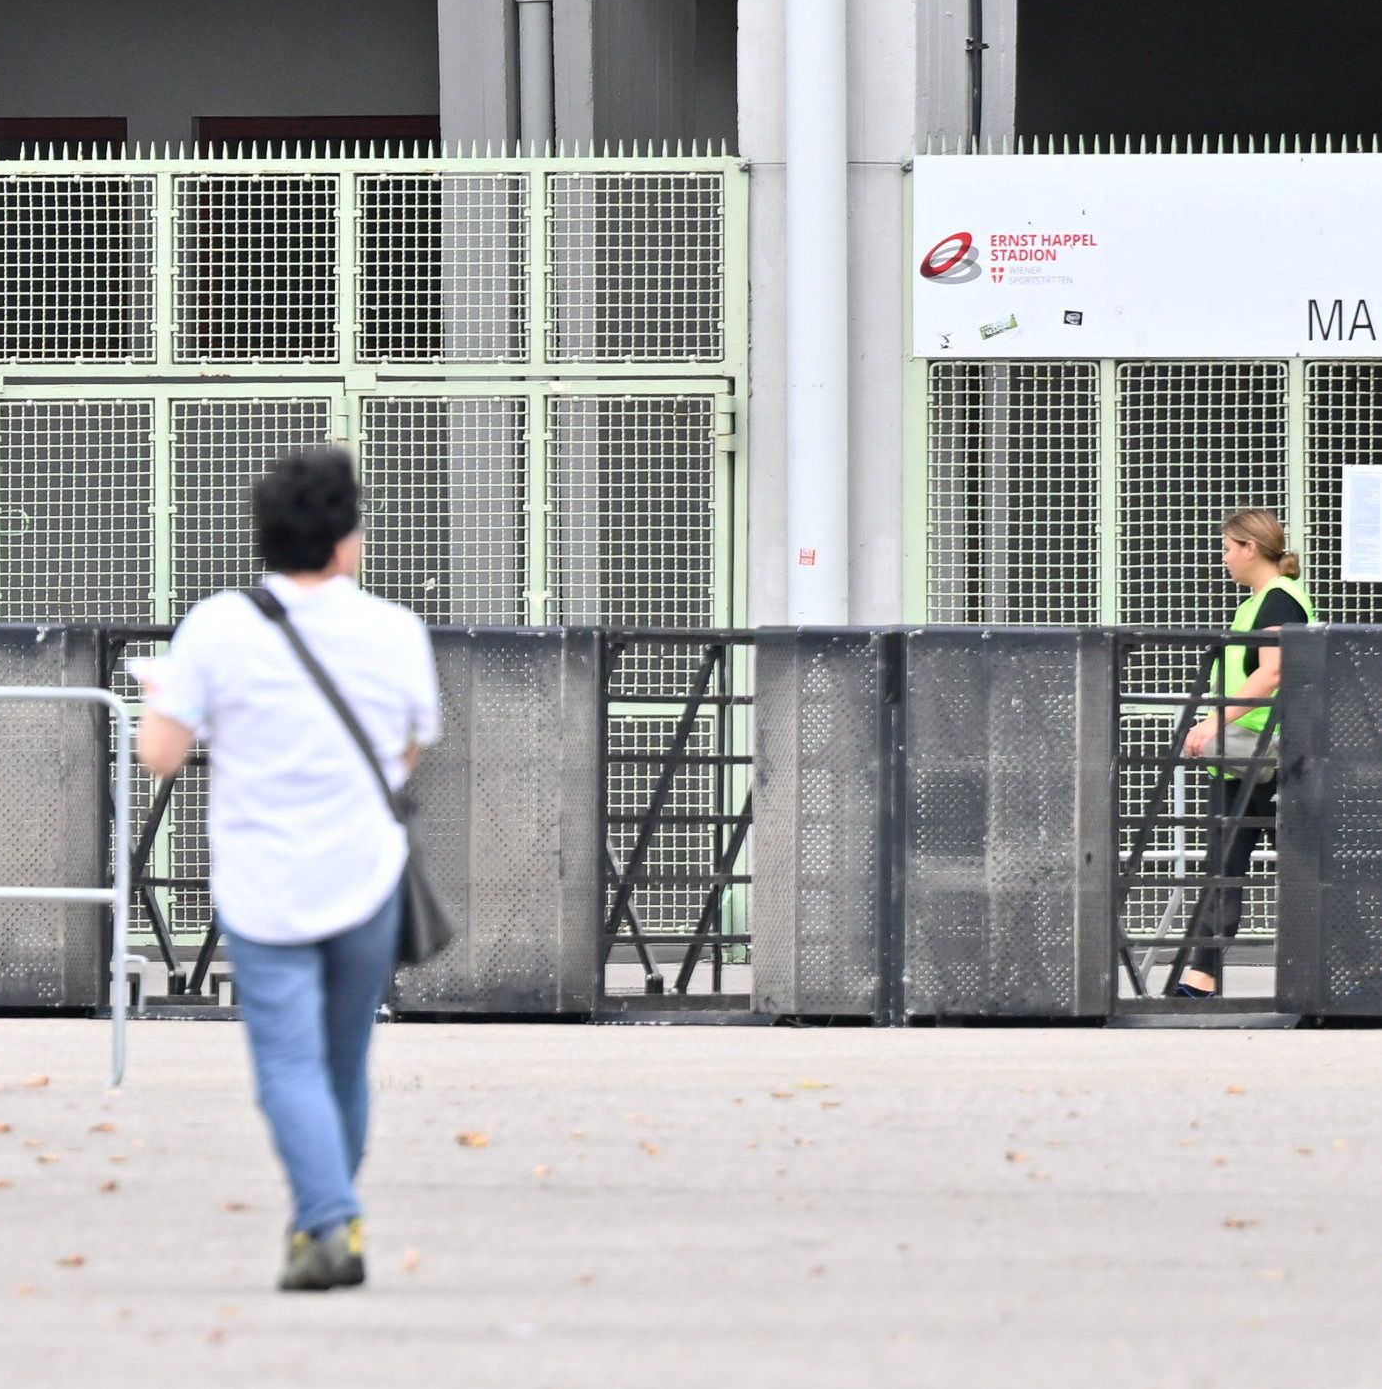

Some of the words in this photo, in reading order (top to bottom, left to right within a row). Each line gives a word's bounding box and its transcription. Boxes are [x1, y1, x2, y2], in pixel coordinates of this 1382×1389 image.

[990, 234, 1037, 247] ERNST
[1041, 234, 1097, 246] HAPPEL
[990, 249, 1057, 261] STADION
[1009, 266, 1041, 275] WIENER
[1308, 299, 1377, 341] MA
